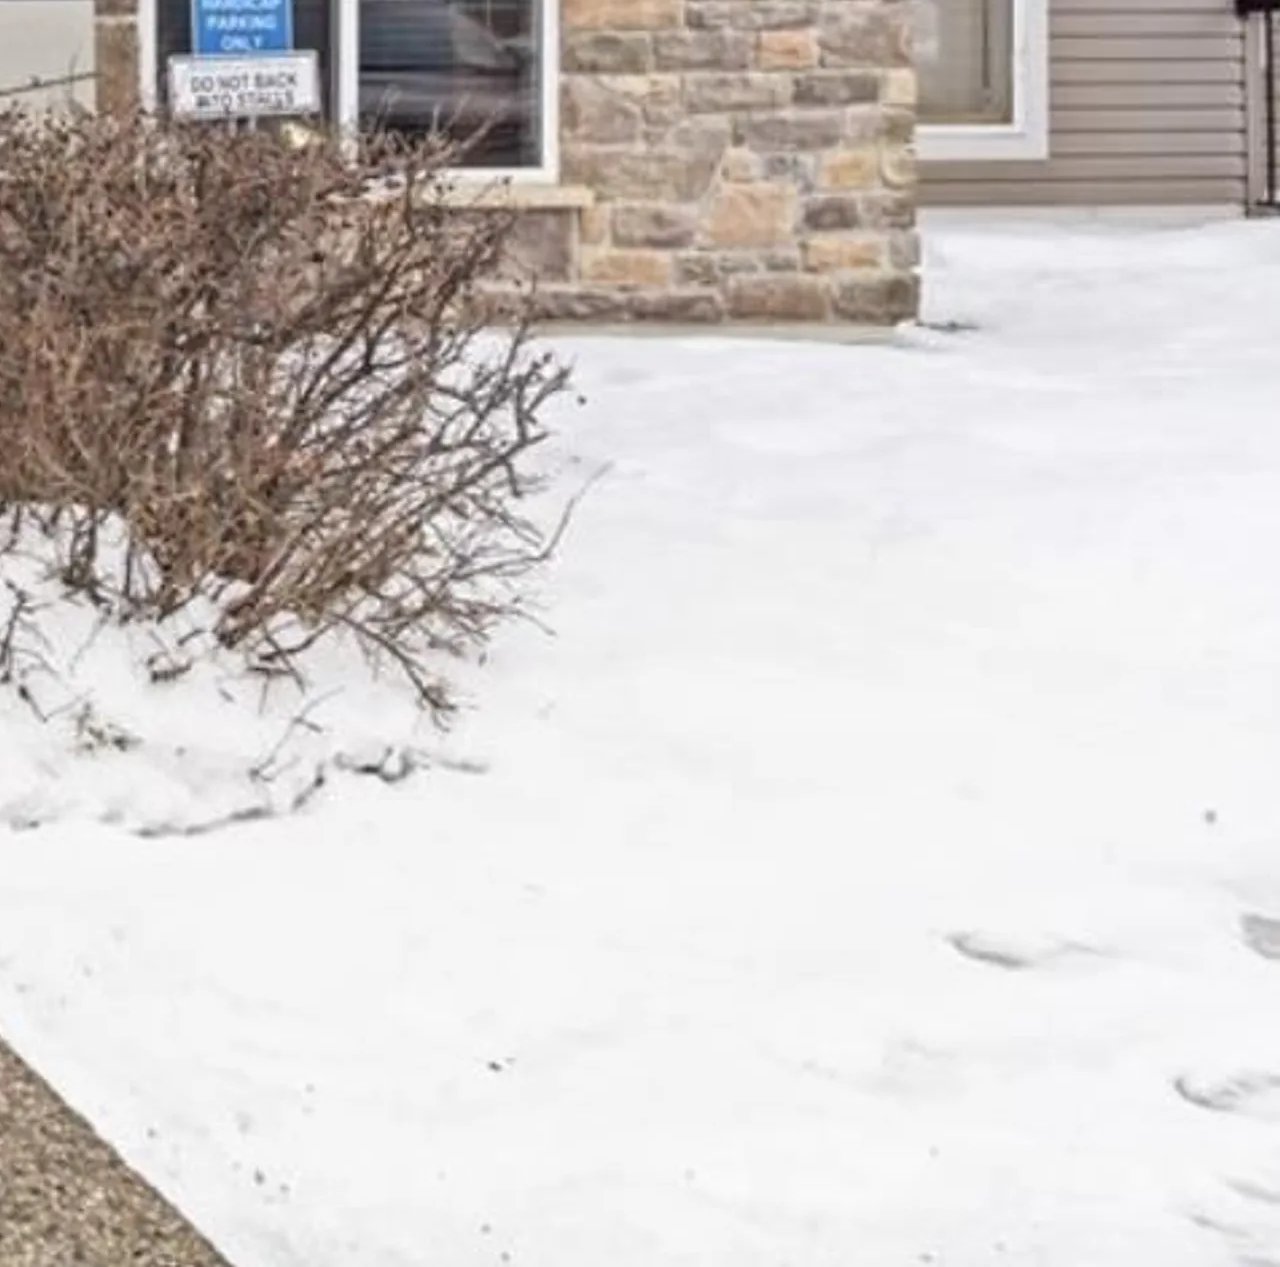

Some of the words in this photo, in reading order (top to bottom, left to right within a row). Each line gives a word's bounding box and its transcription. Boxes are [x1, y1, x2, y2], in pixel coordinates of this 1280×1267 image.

[206, 14, 277, 30] PARKING
[220, 35, 264, 50] ONLY
[191, 75, 214, 93] DO
[216, 73, 249, 91] NOT
[254, 71, 297, 88] BACK
